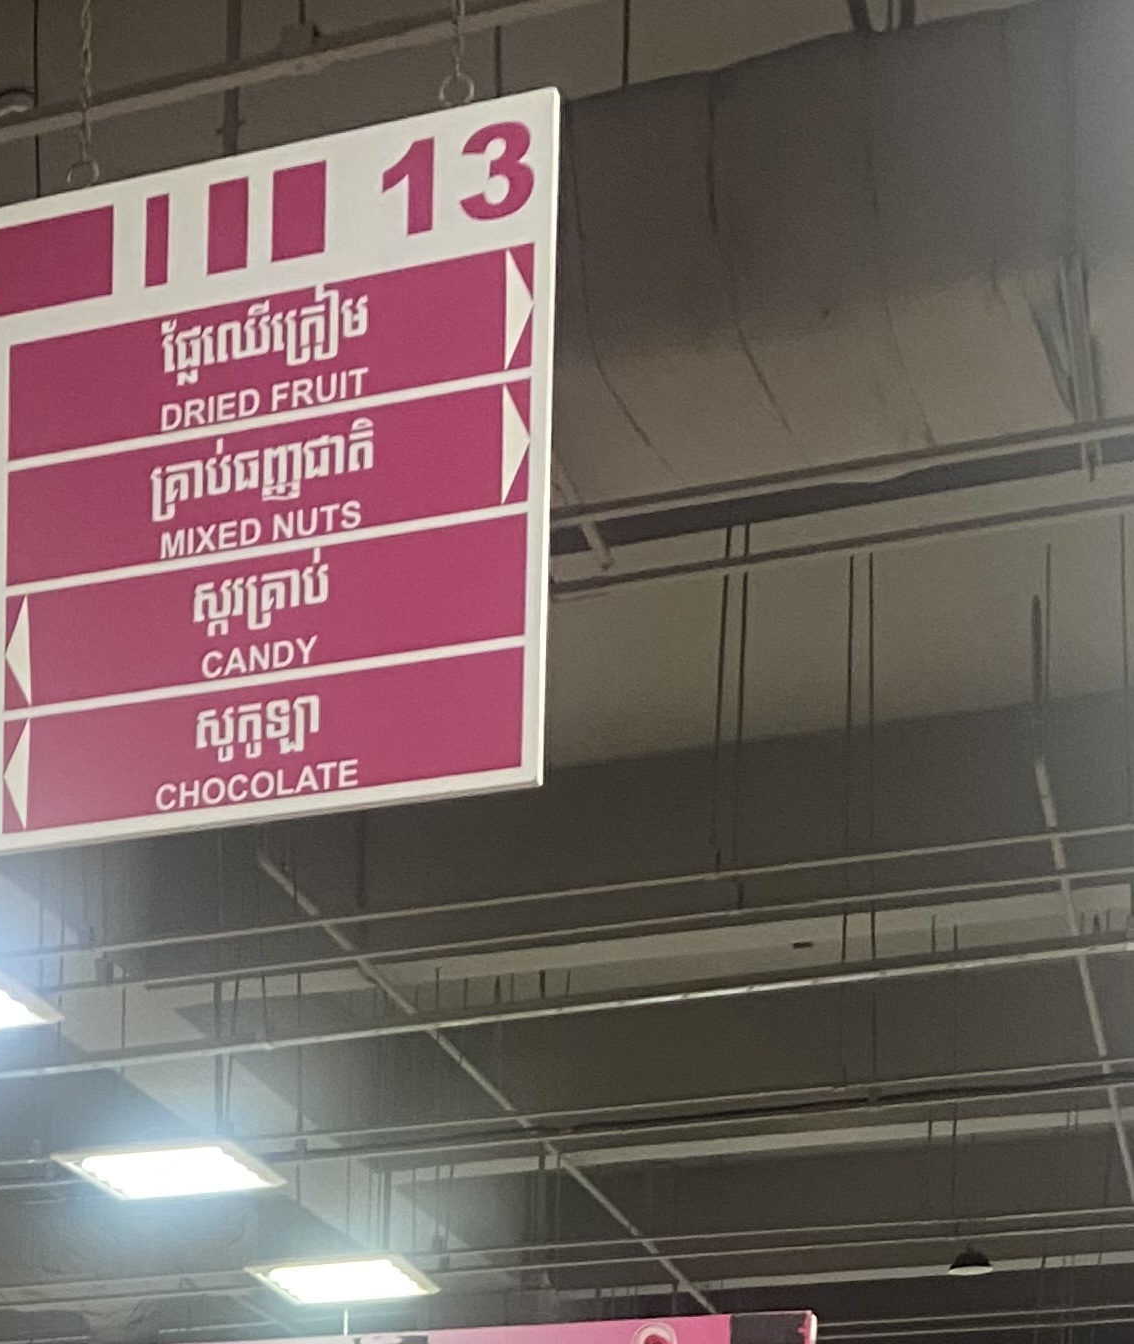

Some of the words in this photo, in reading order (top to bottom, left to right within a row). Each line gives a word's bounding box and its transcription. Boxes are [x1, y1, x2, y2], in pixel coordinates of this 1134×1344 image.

[380, 120, 535, 238] 13
[161, 284, 370, 385] ផ្លែឈើក្រៀម
[160, 386, 262, 433] DRIED
[266, 367, 370, 414] FRUIT
[160, 517, 262, 561] MIXED
[272, 499, 363, 539] NUTS
[193, 549, 330, 637] ស្ករគ្រាប់
[200, 635, 319, 680] CANDY
[195, 692, 321, 763] សូកូឡា
[154, 758, 360, 812] CHOCOLATE
